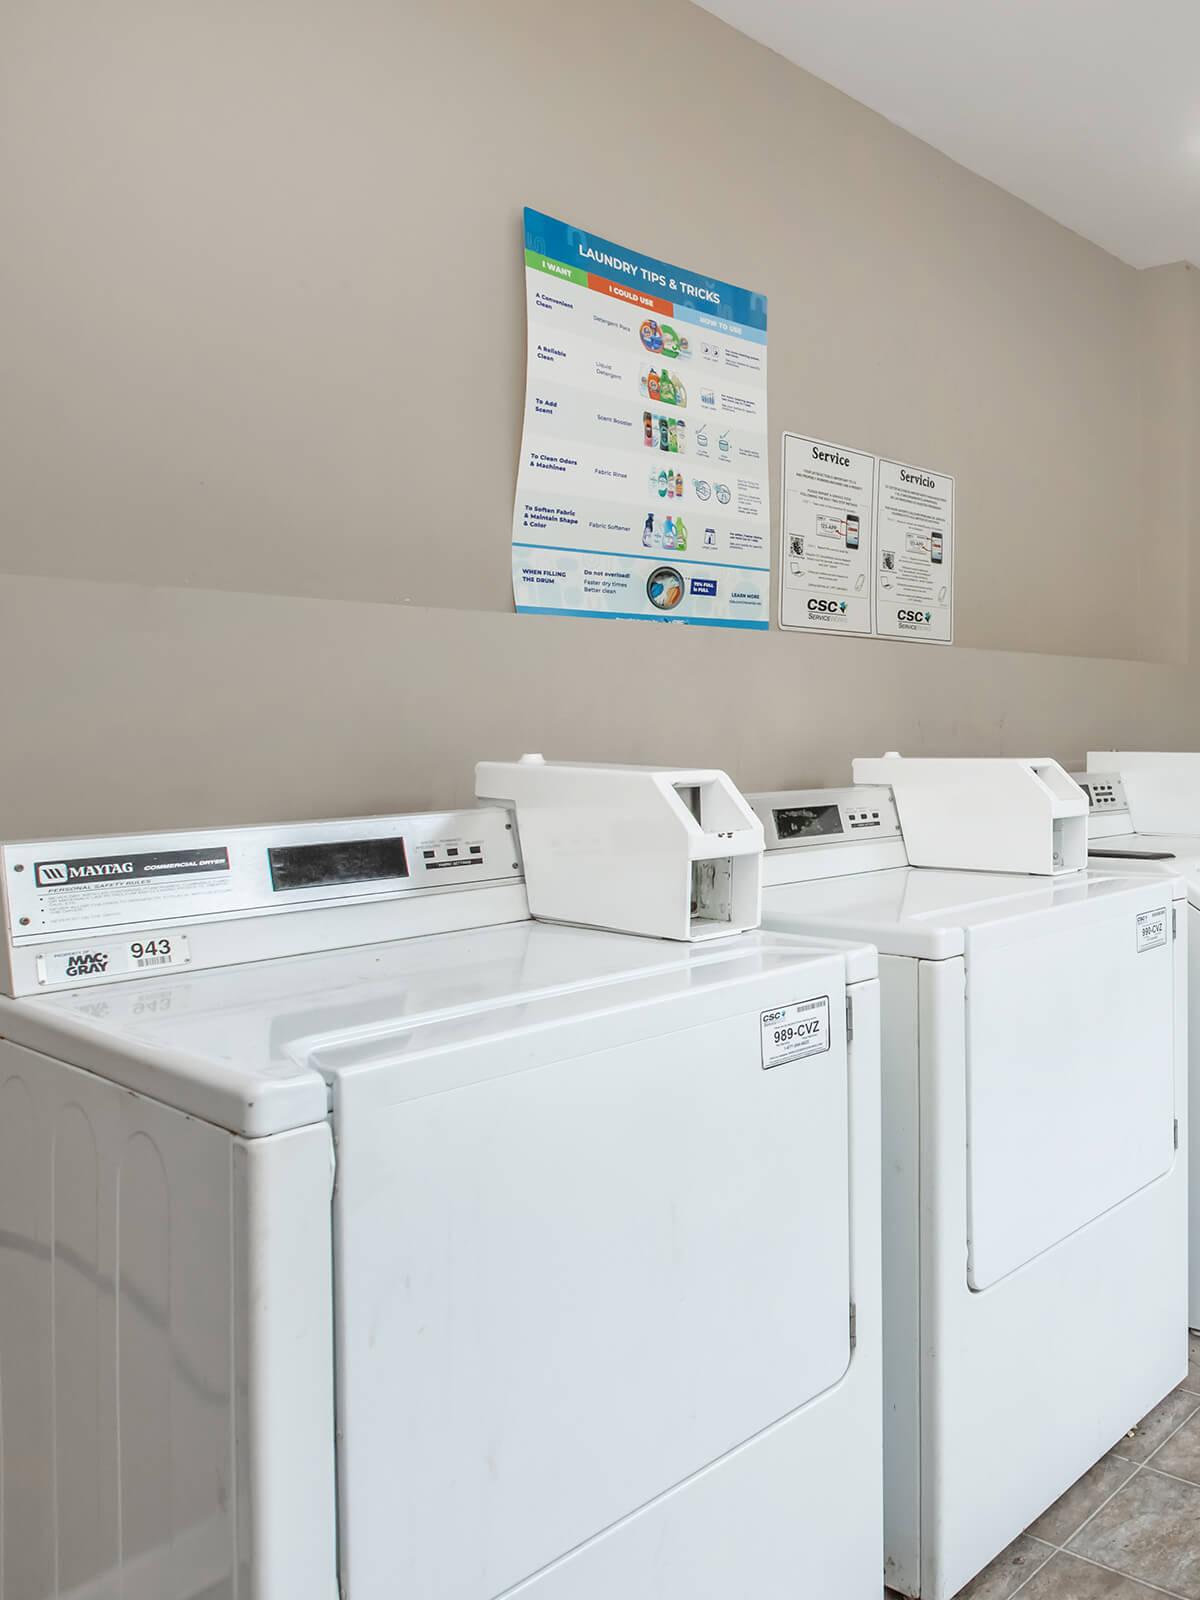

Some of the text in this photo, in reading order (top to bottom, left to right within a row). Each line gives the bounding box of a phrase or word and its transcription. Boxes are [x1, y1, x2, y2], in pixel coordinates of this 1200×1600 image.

[547, 262, 573, 278] WANT
[579, 244, 721, 304] LAUNDRY TIPS & TRICKS
[542, 294, 574, 309] Convenient
[613, 287, 639, 301] COULD
[640, 297, 654, 307] USE
[536, 300, 553, 309] Clean
[593, 315, 618, 327] Detergent
[700, 316, 743, 335] HOW TO USE
[537, 353, 554, 361] Clean
[543, 346, 567, 357] Reliable
[595, 361, 612, 370] Liquid
[596, 368, 622, 380] Detergent
[545, 400, 557, 408] Add
[535, 406, 553, 415] Scent
[597, 414, 612, 423] Scent
[540, 455, 558, 463] Clean
[559, 457, 577, 465] Odors
[812, 446, 850, 467] Service
[536, 461, 566, 471] Machines
[594, 468, 628, 479] Fabric Rinse
[900, 469, 935, 488] Servicio
[534, 506, 555, 514] Soften
[556, 508, 576, 517] Fabric
[529, 521, 547, 529] Color
[530, 514, 558, 522] Maintain
[559, 517, 579, 525] Shape
[607, 524, 631, 532] Softener
[543, 569, 566, 577] FILLING
[604, 571, 631, 579] overload!
[807, 598, 838, 613] CSC
[897, 609, 923, 622] CSC
[68, 857, 227, 879] MAYTAG COMMERCIAL DRYER
[48, 879, 152, 894] PERSONAL SAFETY RULES
[130, 939, 171, 958] 943
[66, 962, 108, 976] GRAY
[763, 1012, 781, 1022] CSC
[774, 1020, 820, 1043] 989-CVZ
